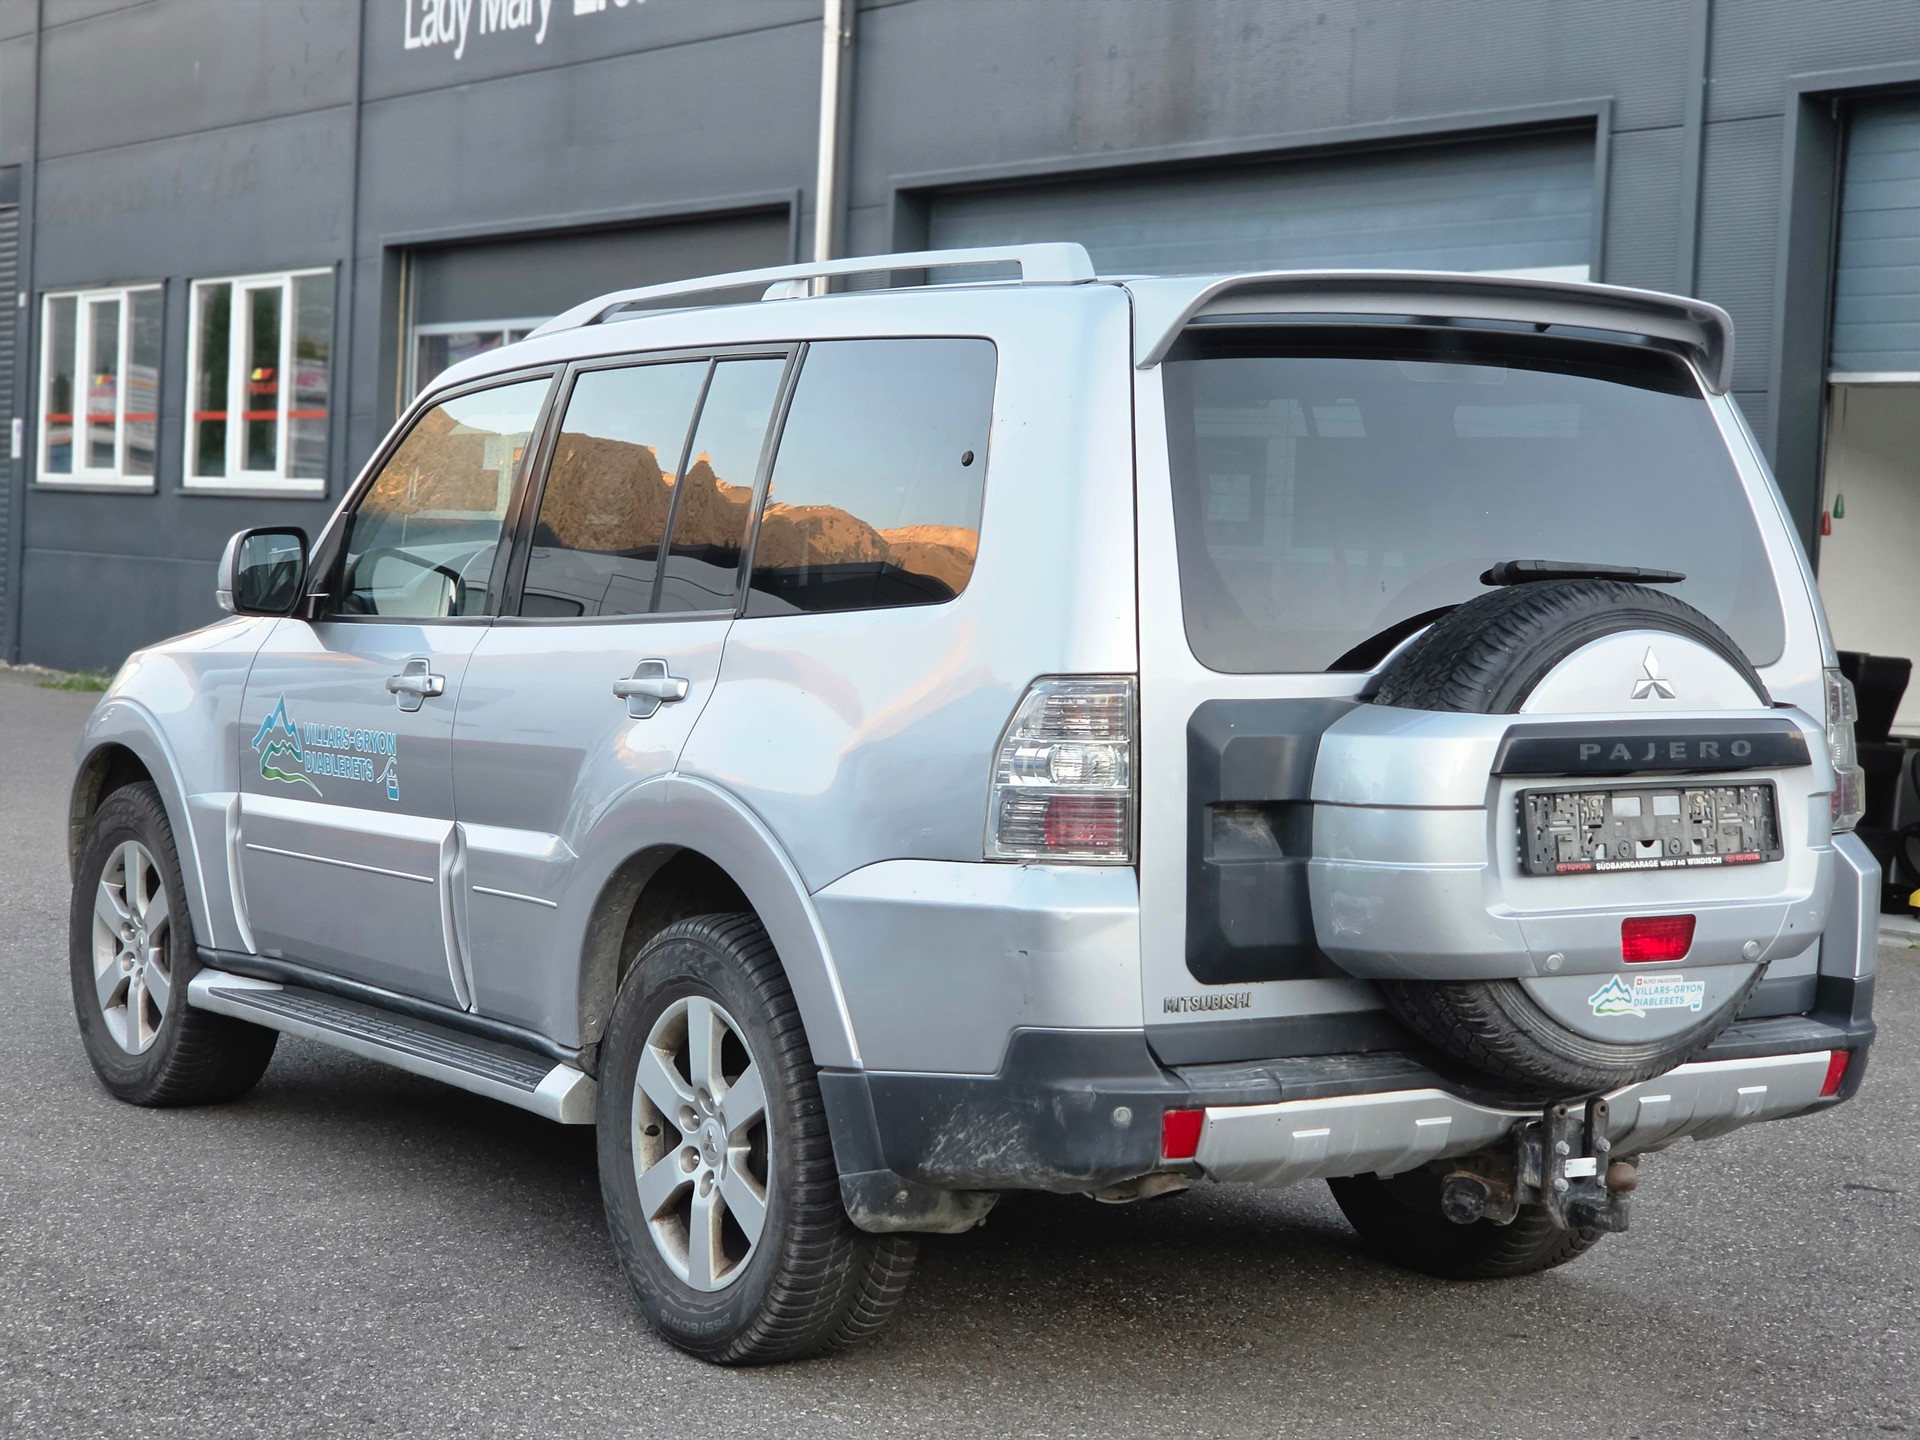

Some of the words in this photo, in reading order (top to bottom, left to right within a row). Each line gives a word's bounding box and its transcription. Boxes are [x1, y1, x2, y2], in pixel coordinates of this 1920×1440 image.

[404, 0, 472, 60] Lady
[303, 722, 397, 756] VILLARS-GRYON
[1579, 740, 1751, 761] PAJERO
[304, 750, 374, 782] DIABLERETS
[1595, 860, 1659, 871] SÜDBAHNGARAGE
[1660, 858, 1677, 867] WÜST
[1677, 858, 1687, 866] AG
[1687, 855, 1723, 866] WINDISCH
[1635, 985, 1702, 995] VILLARS-GRYON
[1163, 992, 1252, 1014] MITSUBISHI
[1634, 996, 1684, 1006] DIABLERETS
